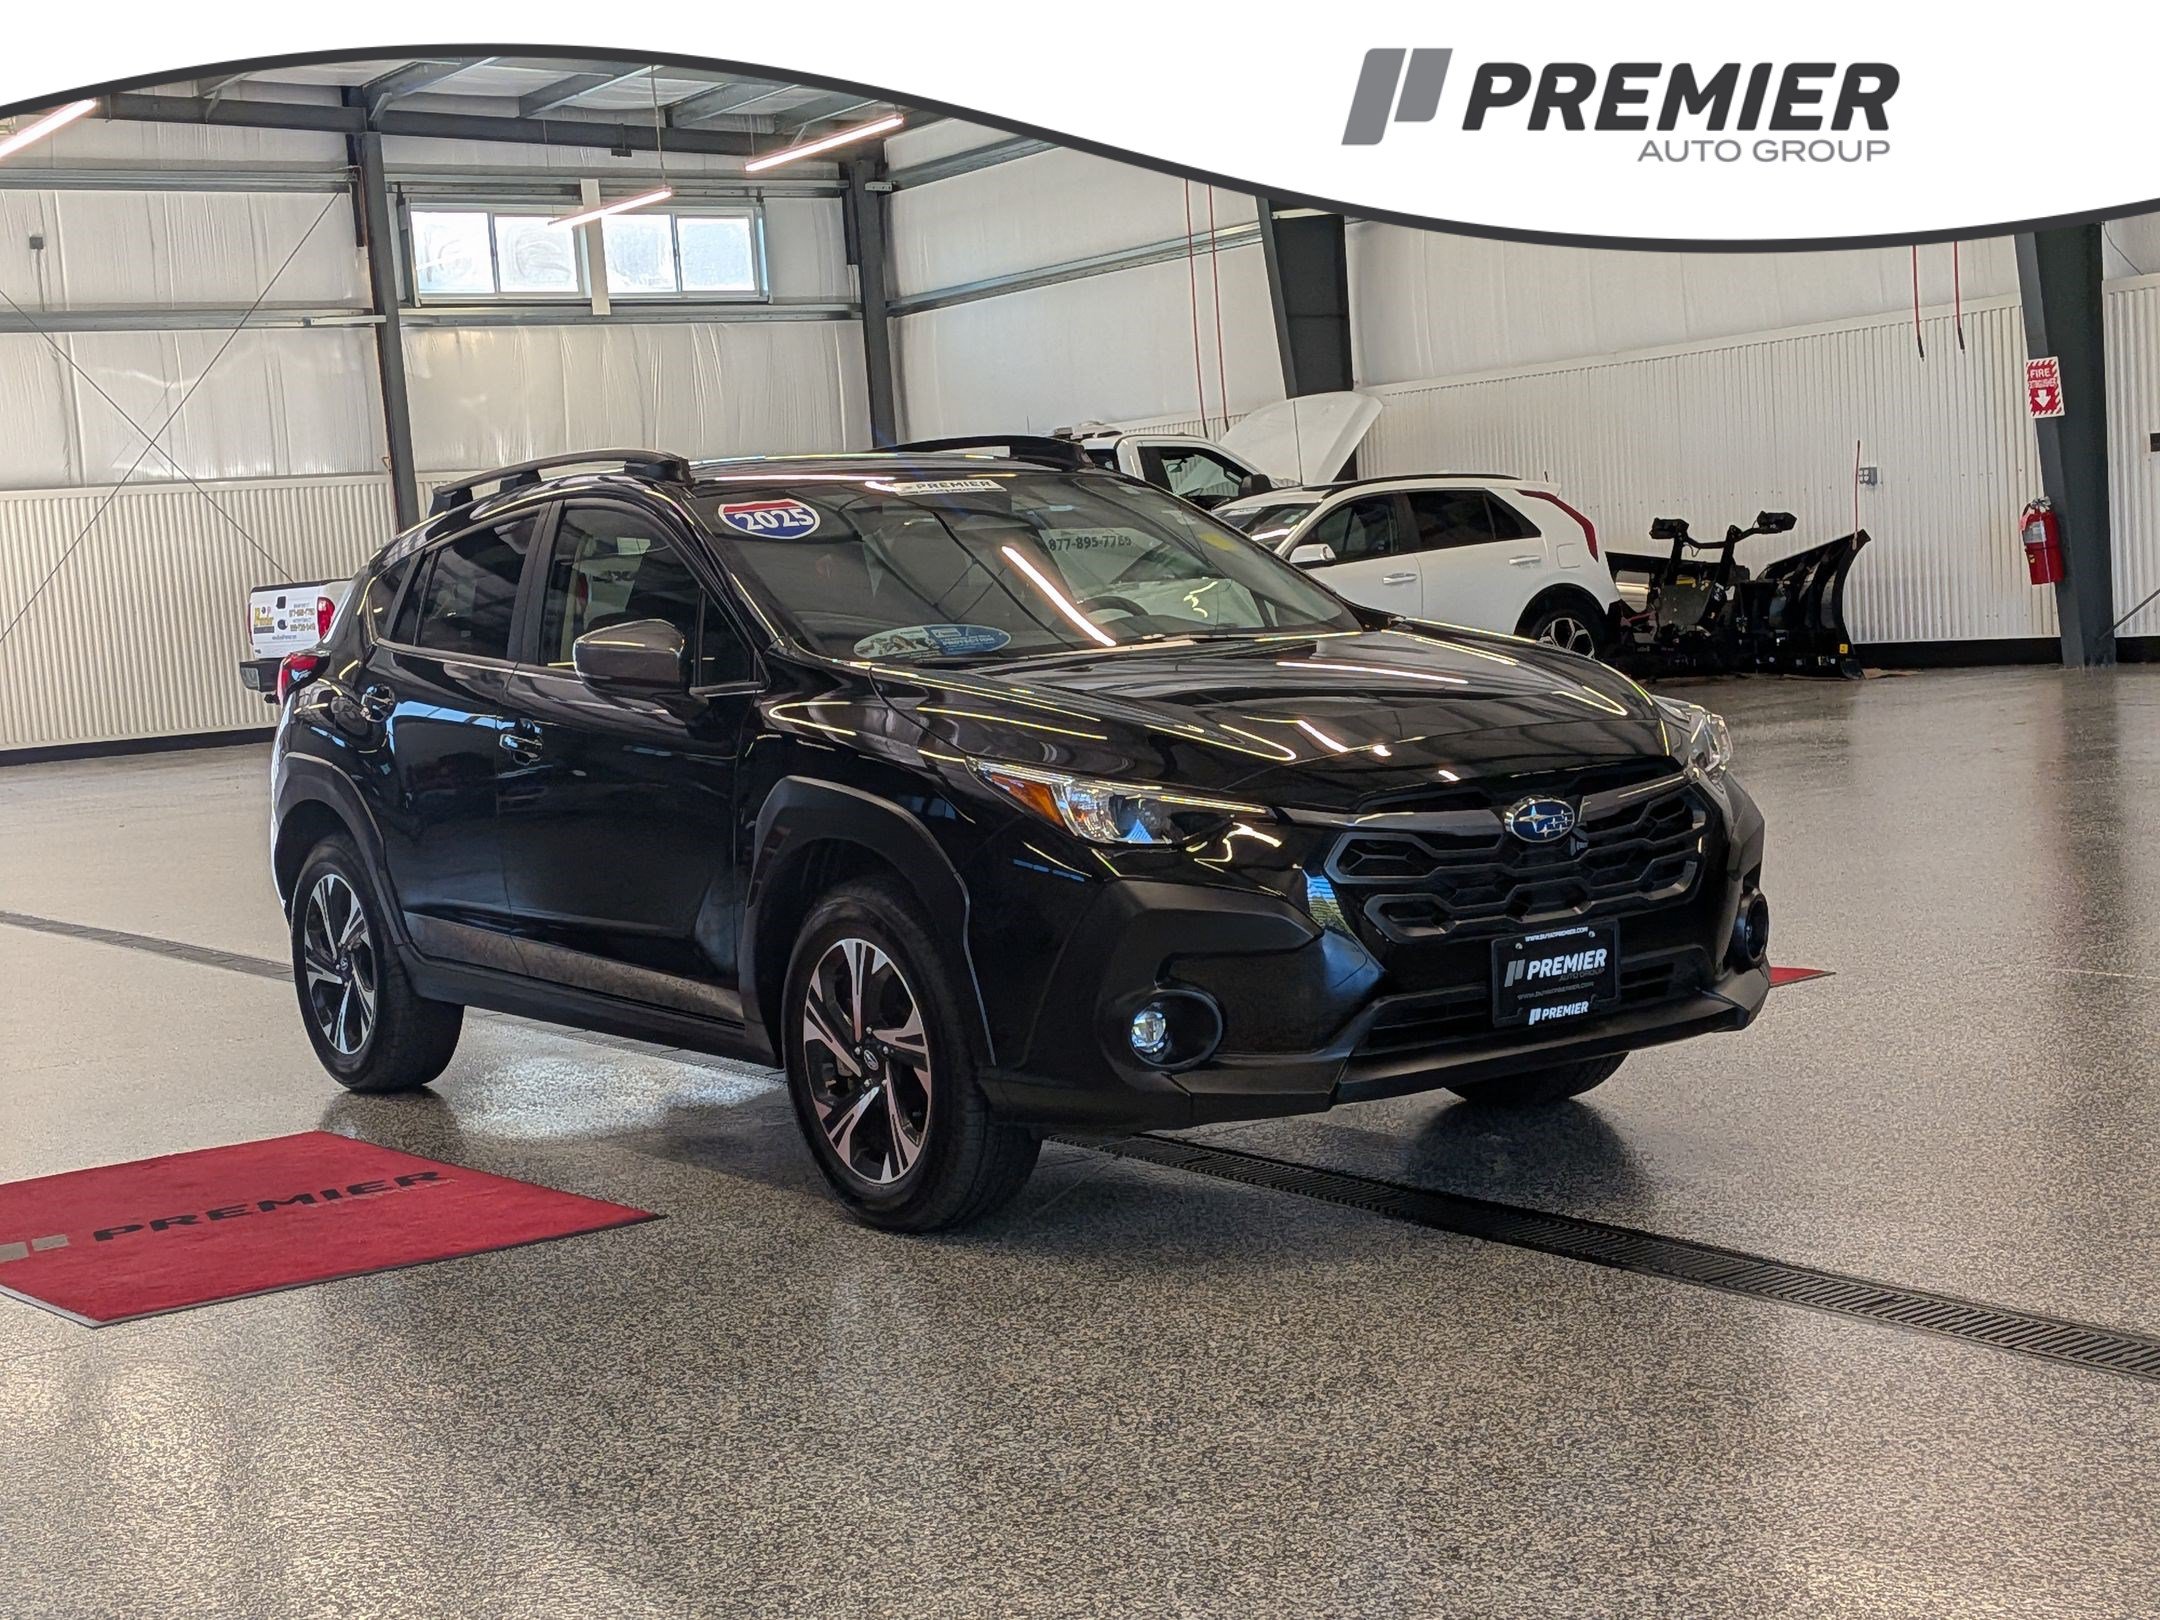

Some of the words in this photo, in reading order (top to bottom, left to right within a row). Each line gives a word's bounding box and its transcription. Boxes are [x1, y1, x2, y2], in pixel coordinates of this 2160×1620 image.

[2030, 367, 2052, 379] FIRE
[916, 481, 991, 489] PREMIER
[734, 509, 814, 530] 2025
[1527, 948, 1607, 980] PREMIER
[1542, 1001, 1588, 1020] PREMIER
[93, 1172, 441, 1242] PREMIER
